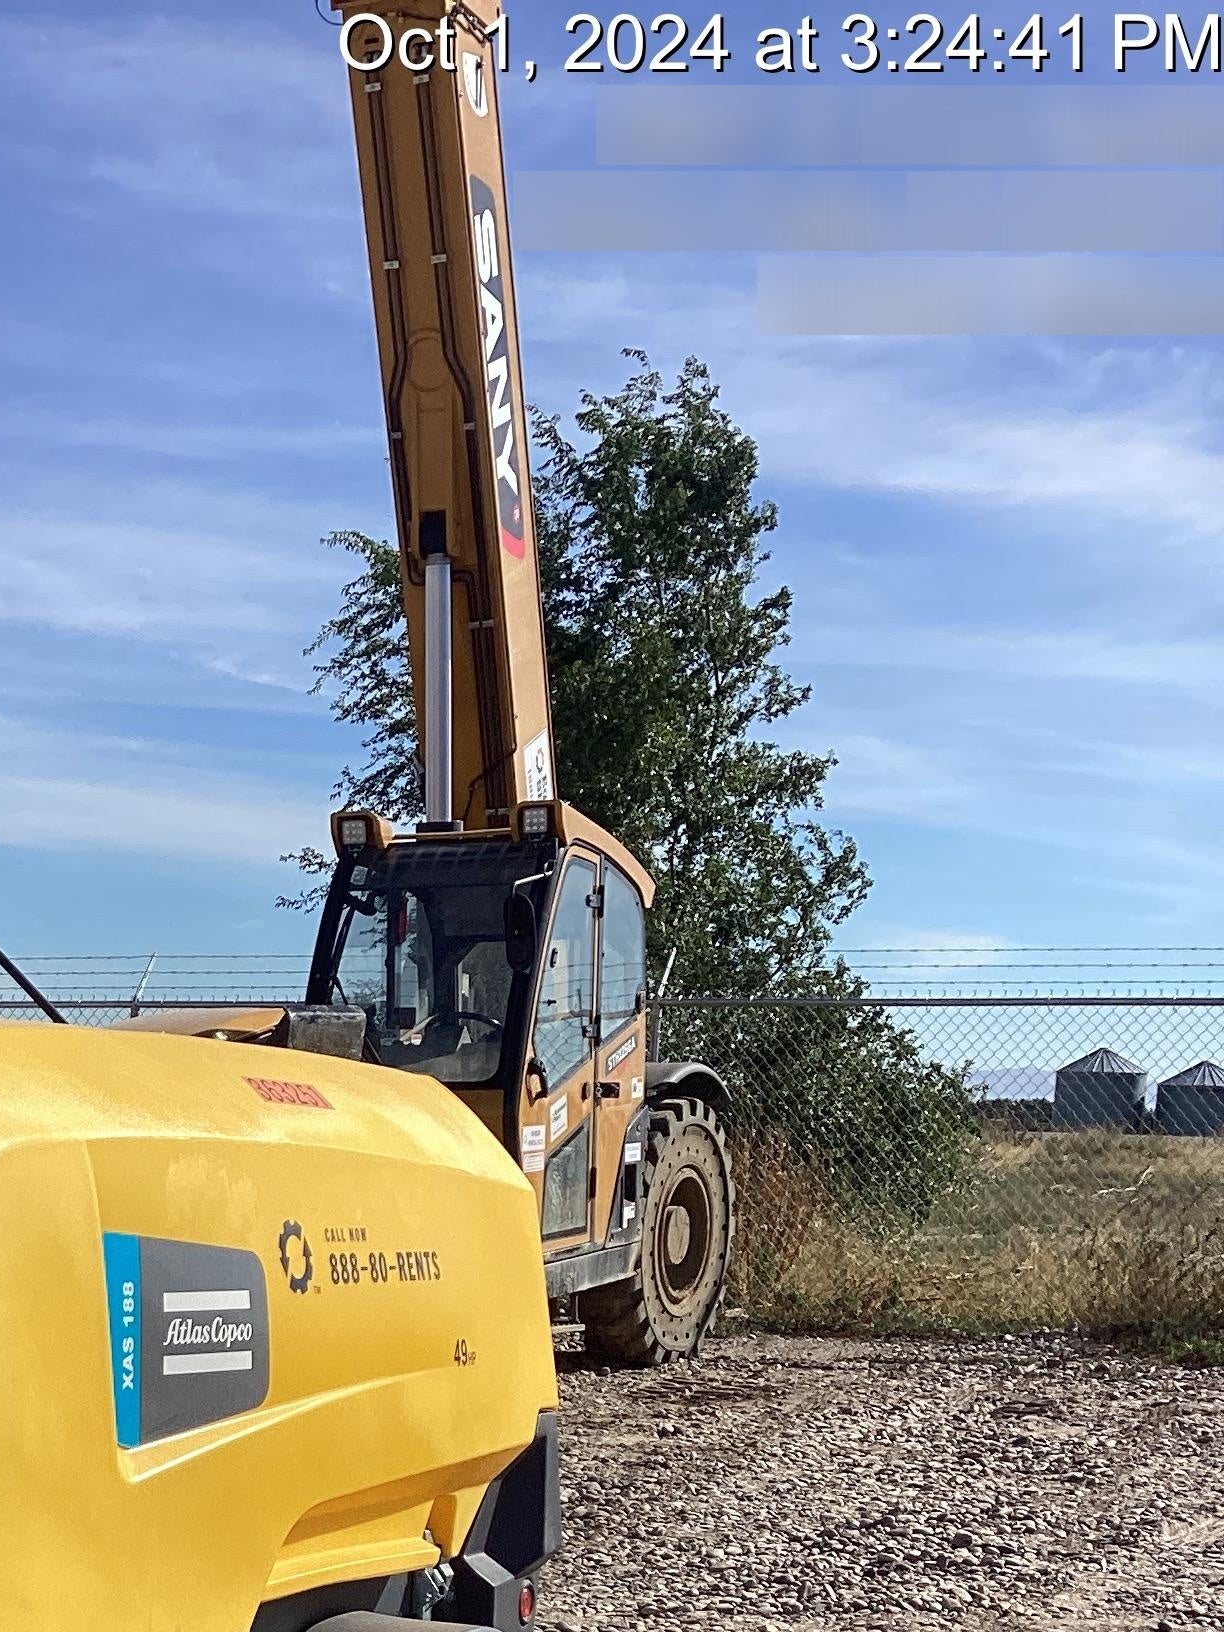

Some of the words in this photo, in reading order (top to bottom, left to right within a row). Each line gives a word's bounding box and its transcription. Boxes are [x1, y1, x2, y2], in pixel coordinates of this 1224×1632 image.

[474, 208, 518, 496] SANY
[247, 1077, 329, 1107] 363251
[324, 1227, 346, 1242] CALL
[349, 1227, 367, 1242] NOW
[329, 1250, 441, 1285] 888-80-RENTS
[122, 1281, 135, 1328] 188
[122, 1336, 135, 1390] XAS
